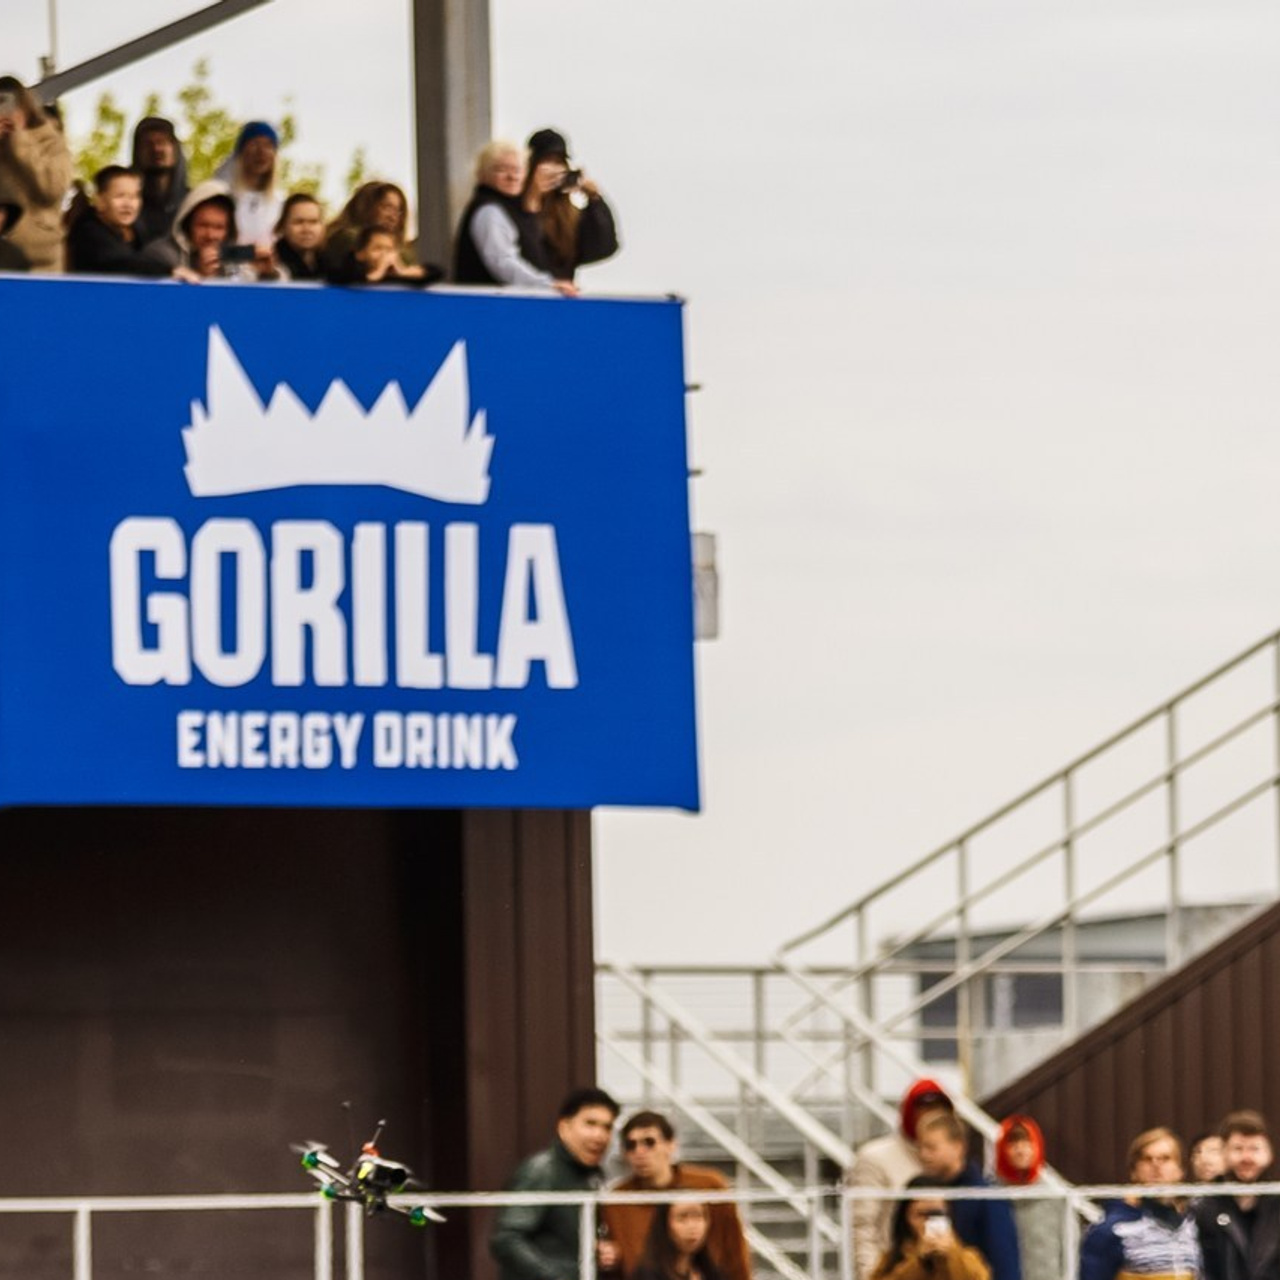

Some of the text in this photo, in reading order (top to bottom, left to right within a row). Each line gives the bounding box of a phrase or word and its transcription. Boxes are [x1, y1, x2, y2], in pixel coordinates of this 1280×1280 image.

[110, 516, 578, 690] GORILLA
[177, 711, 518, 770] ENERGY DRINK
